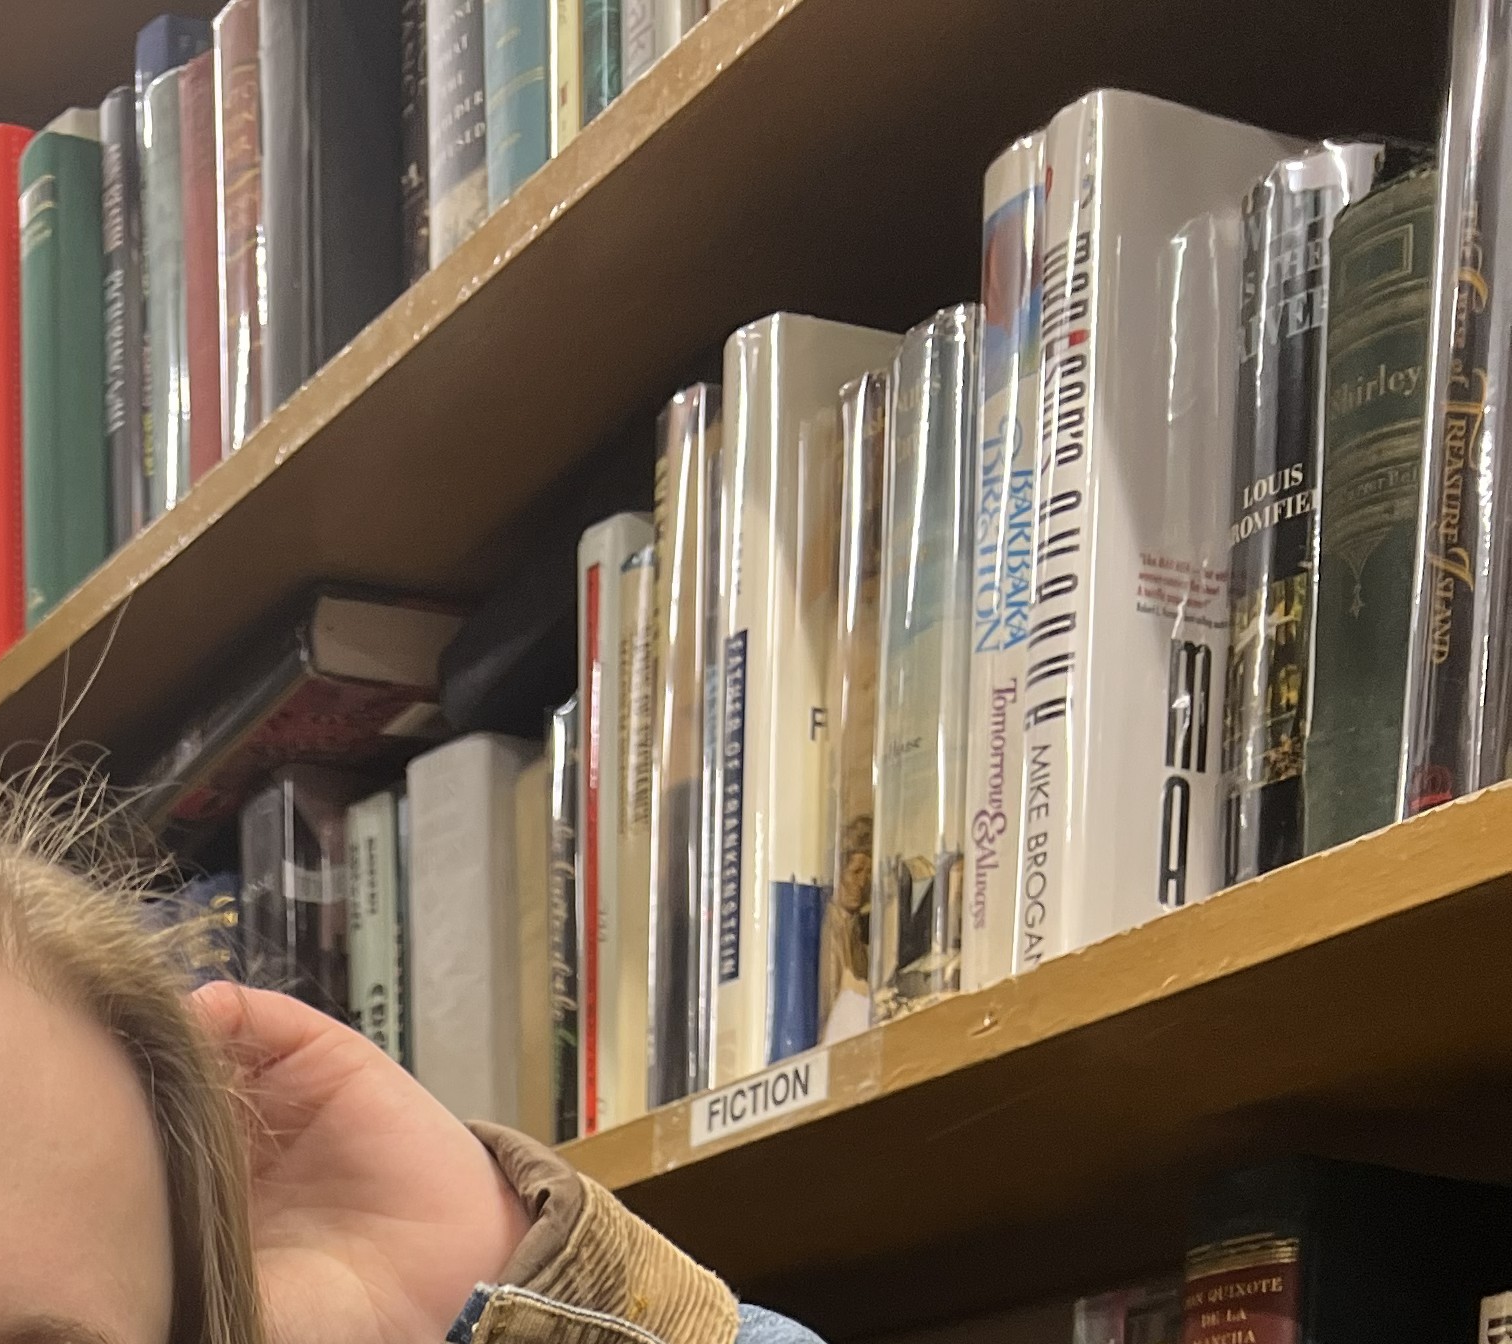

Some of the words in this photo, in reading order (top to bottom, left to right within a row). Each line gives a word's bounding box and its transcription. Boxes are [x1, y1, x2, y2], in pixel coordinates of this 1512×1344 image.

[1449, 359, 1469, 389] of
[1231, 488, 1318, 545] ROMFIE
[1243, 463, 1303, 510] LOUIS
[974, 436, 1006, 654] BRETTON
[1003, 468, 1034, 651] BARBARA
[725, 637, 745, 728] FATHER
[724, 739, 741, 770] OF
[988, 677, 1017, 811] Tomorrow
[1028, 744, 1052, 823] MIKE
[719, 784, 740, 976] FRANKENSTEIN
[972, 840, 999, 930] Always
[707, 1064, 809, 1132] FICTION
[1201, 1312, 1220, 1328] DE
[1227, 1308, 1247, 1322] LA
[1207, 1277, 1283, 1301] QUIXOTE
